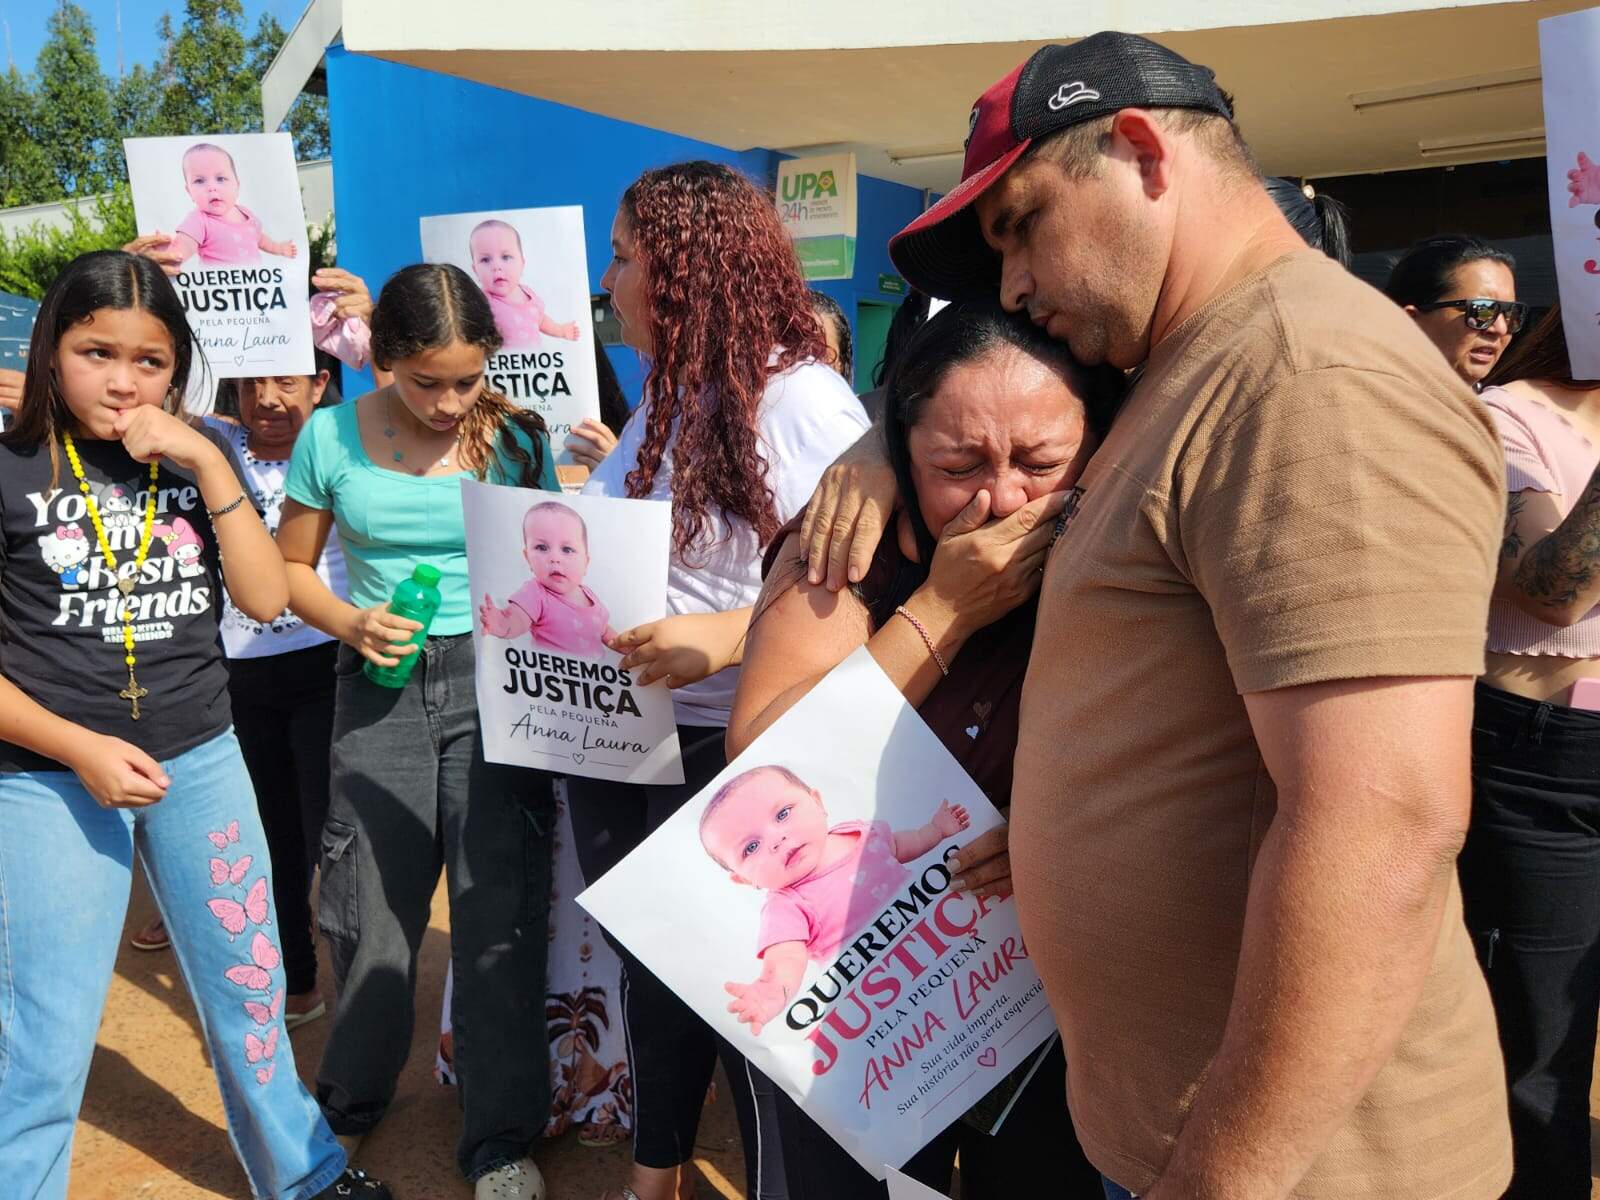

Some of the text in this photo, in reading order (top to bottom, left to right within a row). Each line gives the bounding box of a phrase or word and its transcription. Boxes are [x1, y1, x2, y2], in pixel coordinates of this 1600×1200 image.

[782, 171, 838, 202] UPA
[782, 202, 808, 223] 24h
[176, 268, 283, 288] QUEREMOS
[182, 286, 287, 316] JUSTIÇA
[227, 317, 271, 326] PEQUENA
[242, 326, 291, 351] Laura
[488, 352, 564, 370] EREMOS
[484, 372, 572, 403] STIÇA
[25, 488, 98, 527] Yo
[52, 582, 210, 627] Friends
[134, 630, 173, 642] RIENDS
[504, 647, 632, 687] QUEREMOS
[503, 668, 642, 718] JUSTIÇA
[529, 704, 619, 729] PELA PEQUENA
[510, 713, 650, 754] Anna Laura
[866, 935, 988, 1049] PELA PEQUENA
[897, 979, 1045, 1116] Sua história não será esquecid
[921, 995, 1011, 1074] Sua vida importa.
[858, 1010, 947, 1110] ANNA
